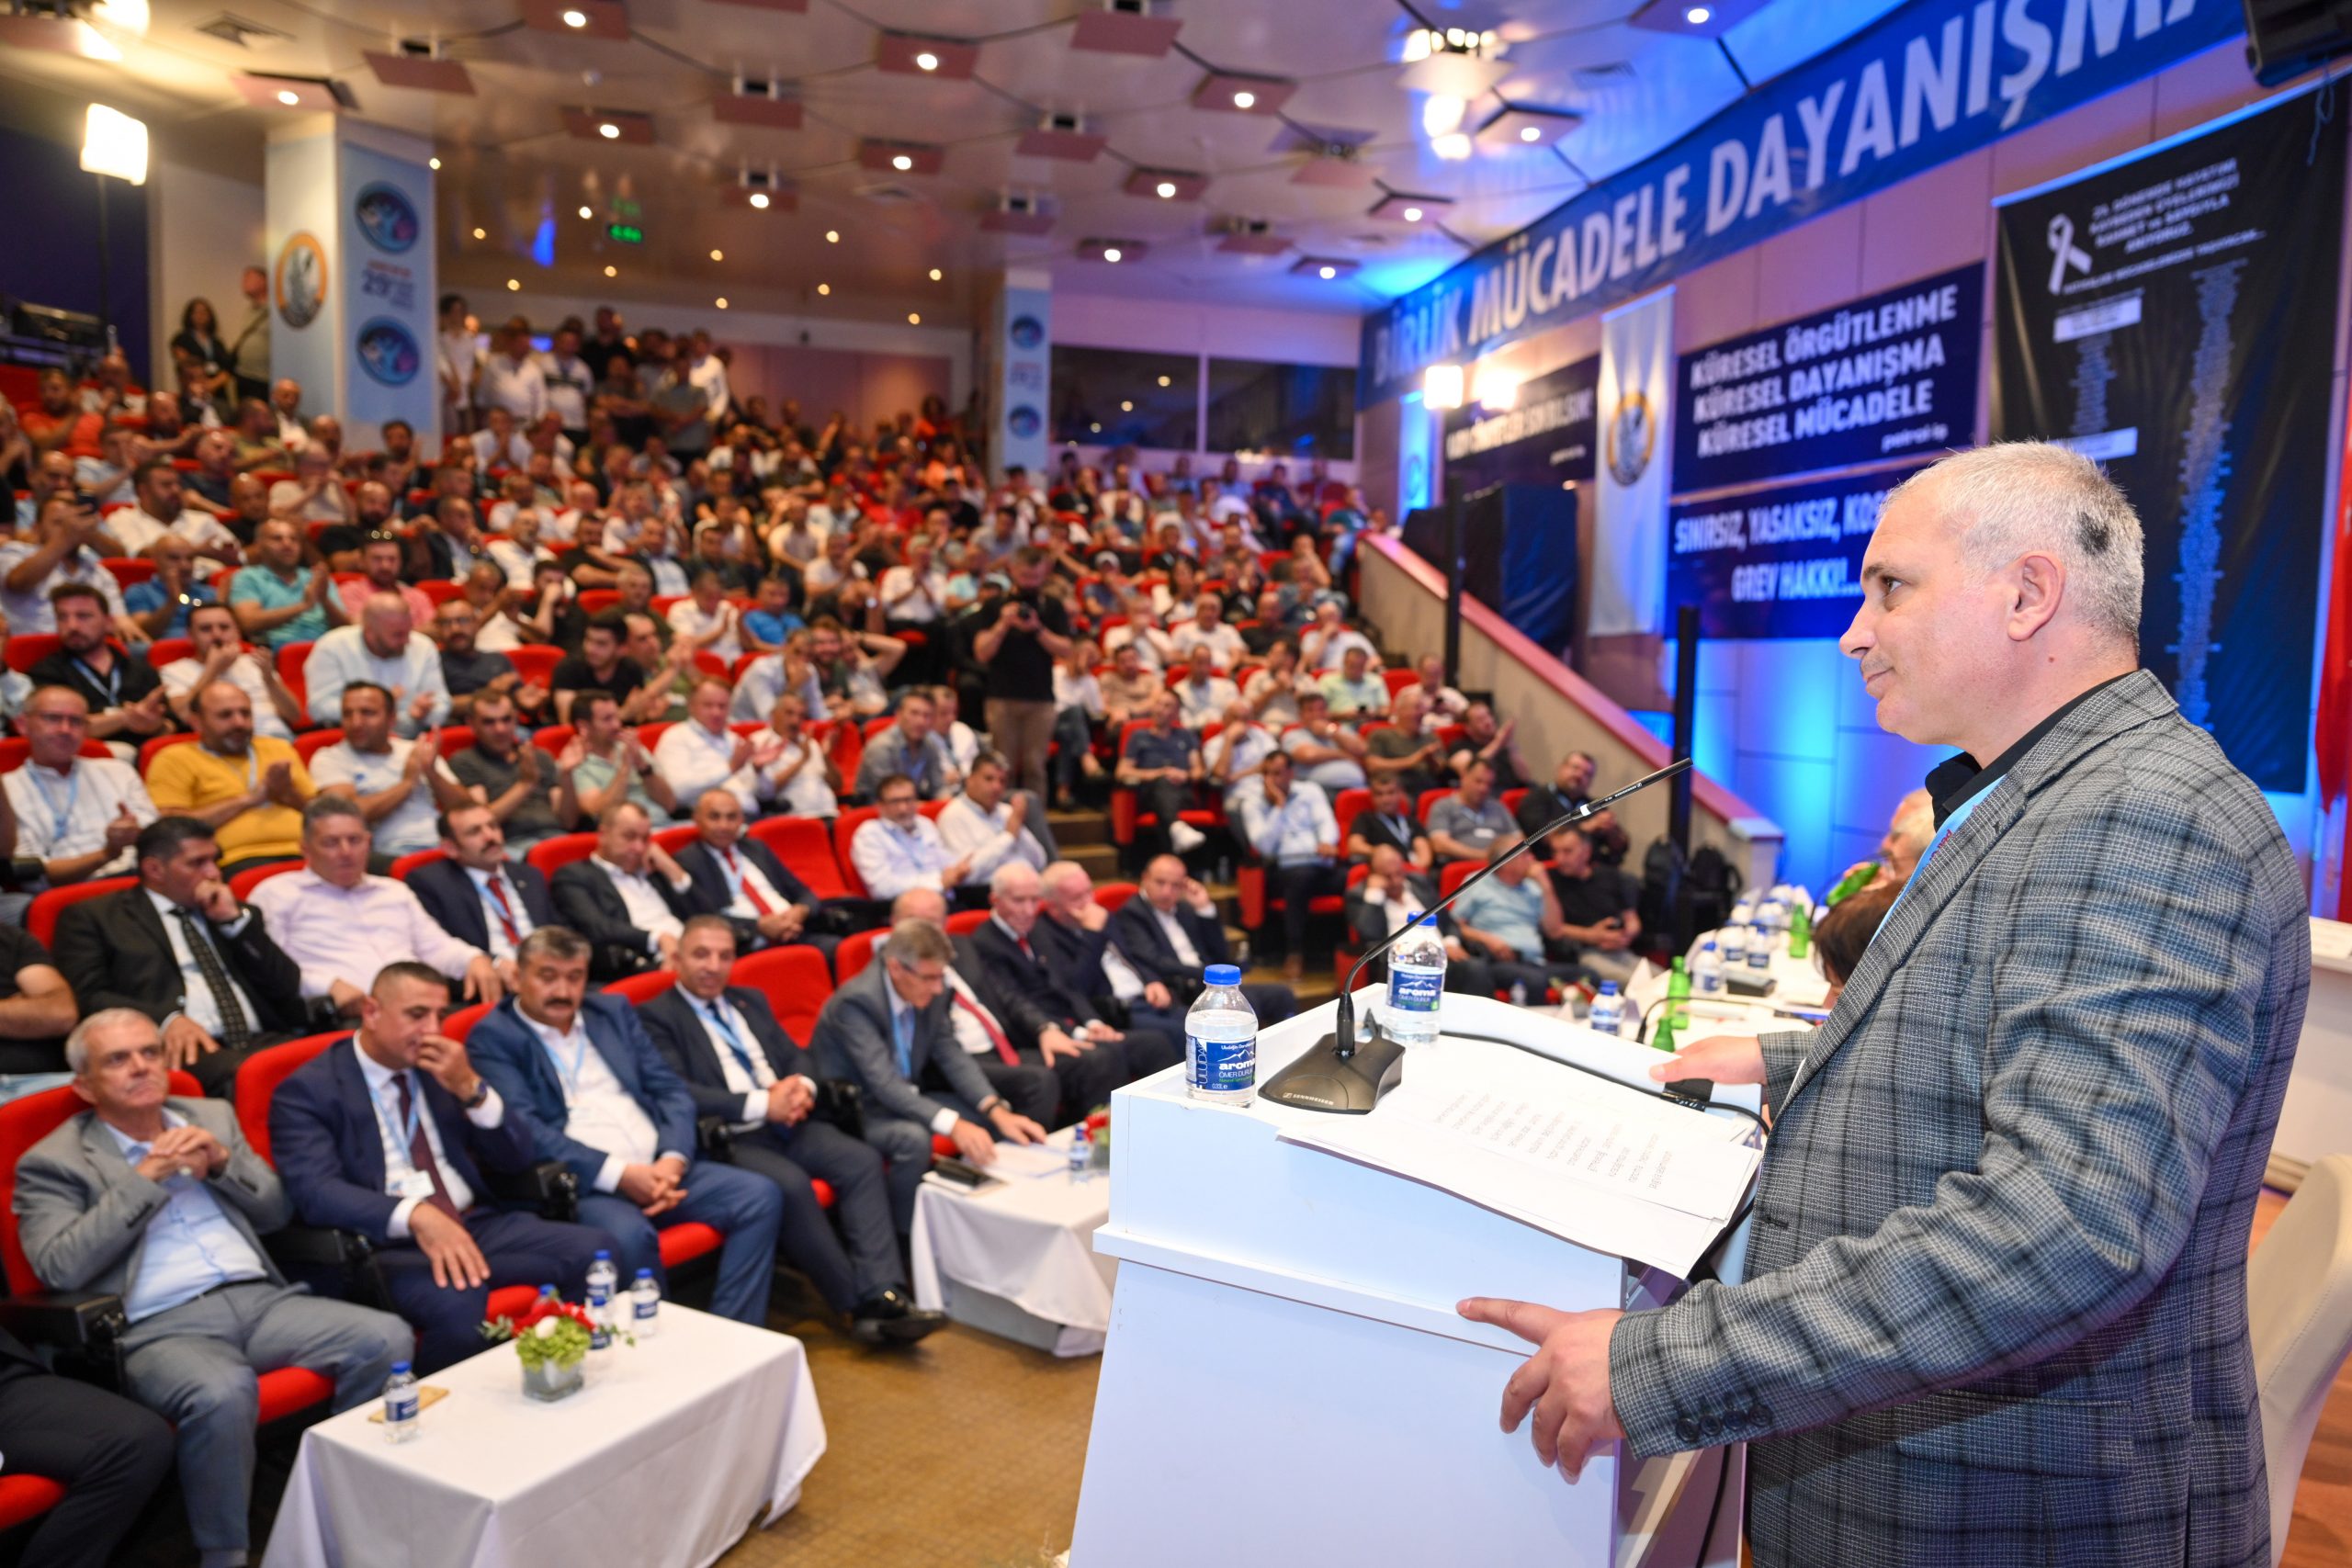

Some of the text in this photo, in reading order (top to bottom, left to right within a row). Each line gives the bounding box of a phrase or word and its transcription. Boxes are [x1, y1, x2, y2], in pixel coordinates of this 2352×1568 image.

[1467, 164, 1690, 345] MÜCADELE
[1705, 0, 2197, 236] DAYANIŞM
[1690, 284, 1959, 389] KÜRESEL ÖRGÜTLENME
[1693, 333, 1946, 424] KÜRESEL DAYANIŞMA
[1698, 379, 1935, 459] KÜRESEL MÜCADELE
[1293, 1093, 1334, 1106] SENNHEISER
